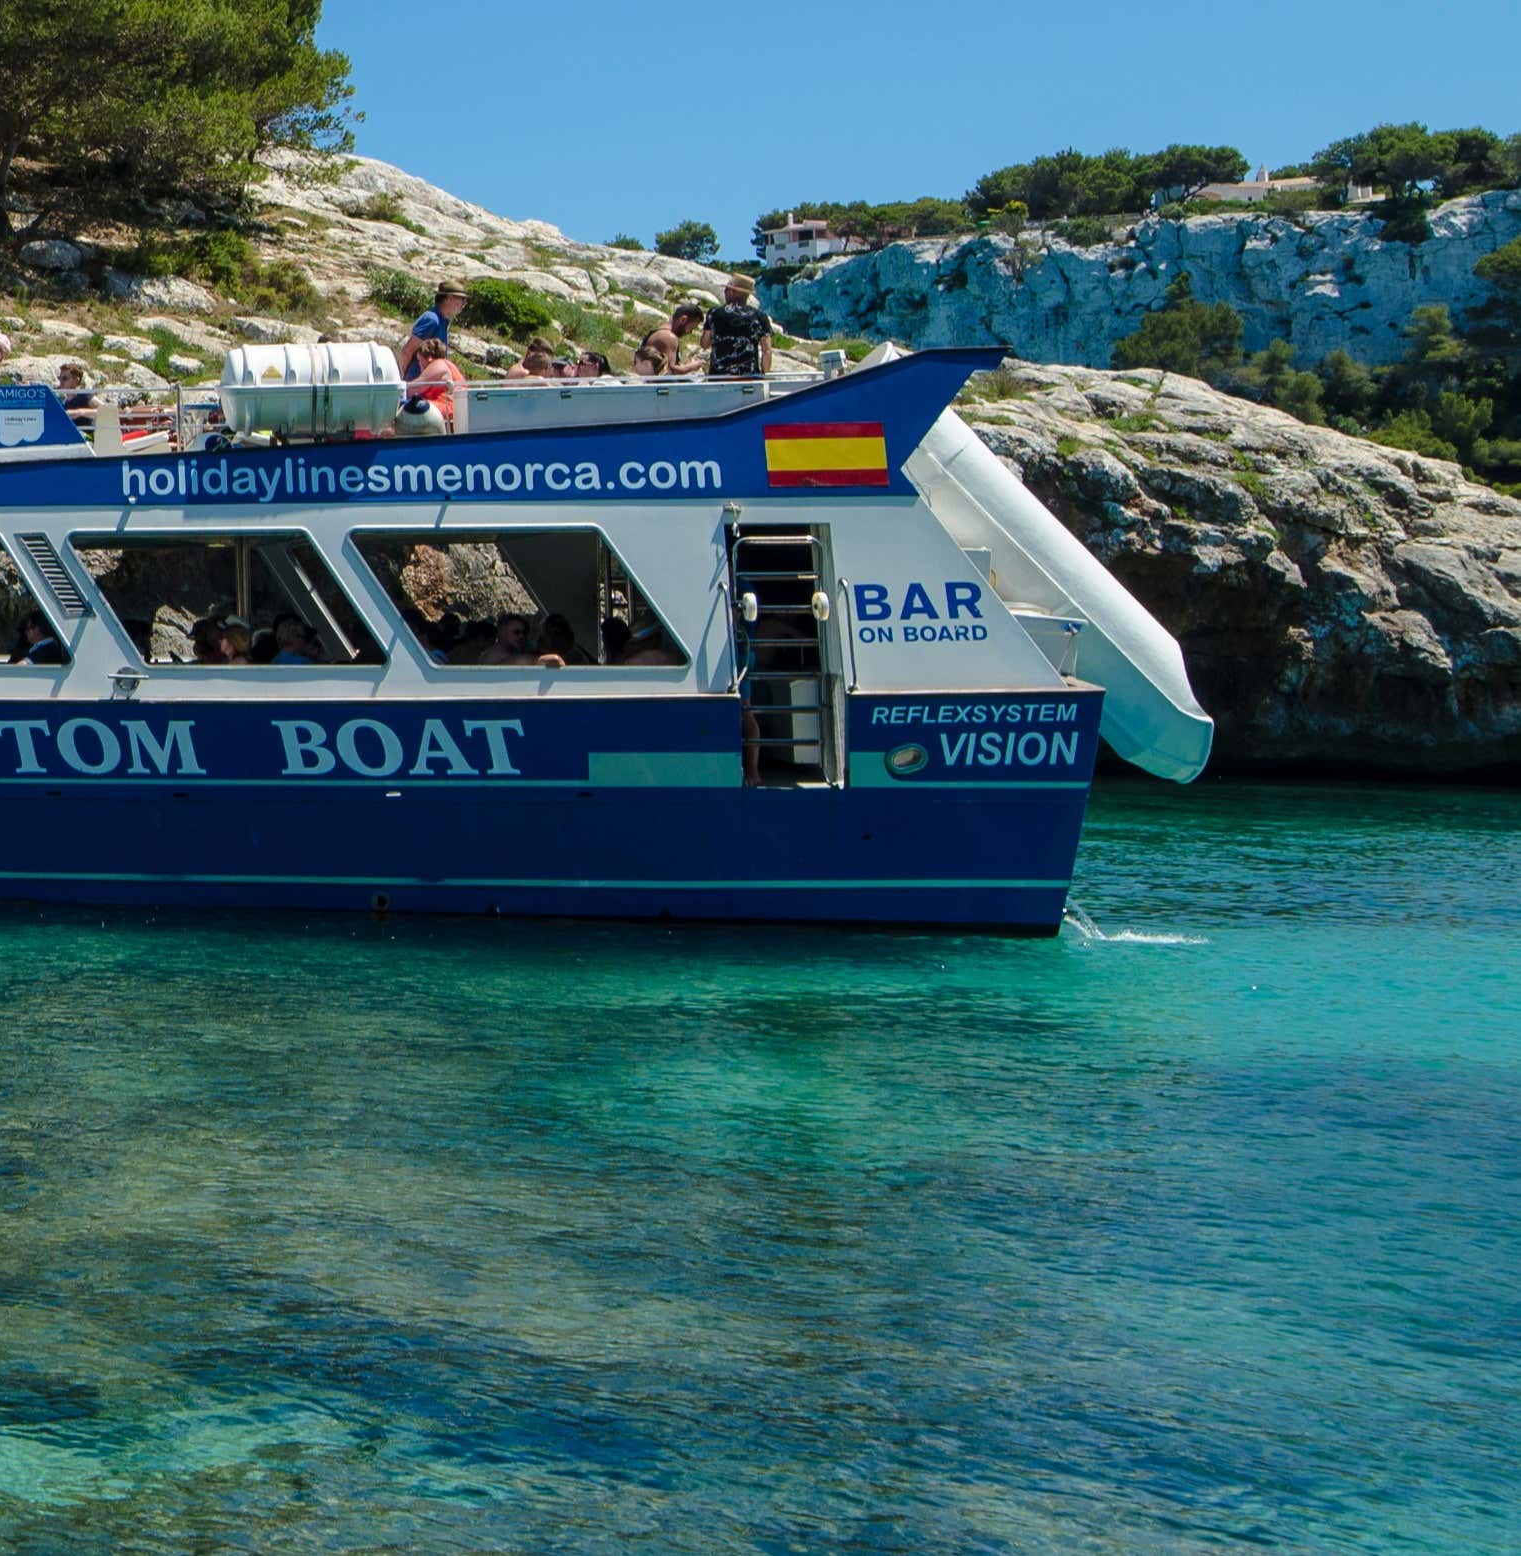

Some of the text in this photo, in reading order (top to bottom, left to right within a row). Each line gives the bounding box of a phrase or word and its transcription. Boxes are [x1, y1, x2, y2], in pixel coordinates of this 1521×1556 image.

[122, 458, 722, 502] holidaylinesmenorca.com
[854, 582, 983, 621] BAR
[859, 625, 988, 643] ON BOARD
[871, 703, 1078, 725] REFLEXSYSTEM
[271, 718, 525, 777] BOAT
[940, 731, 1079, 766] VISION
